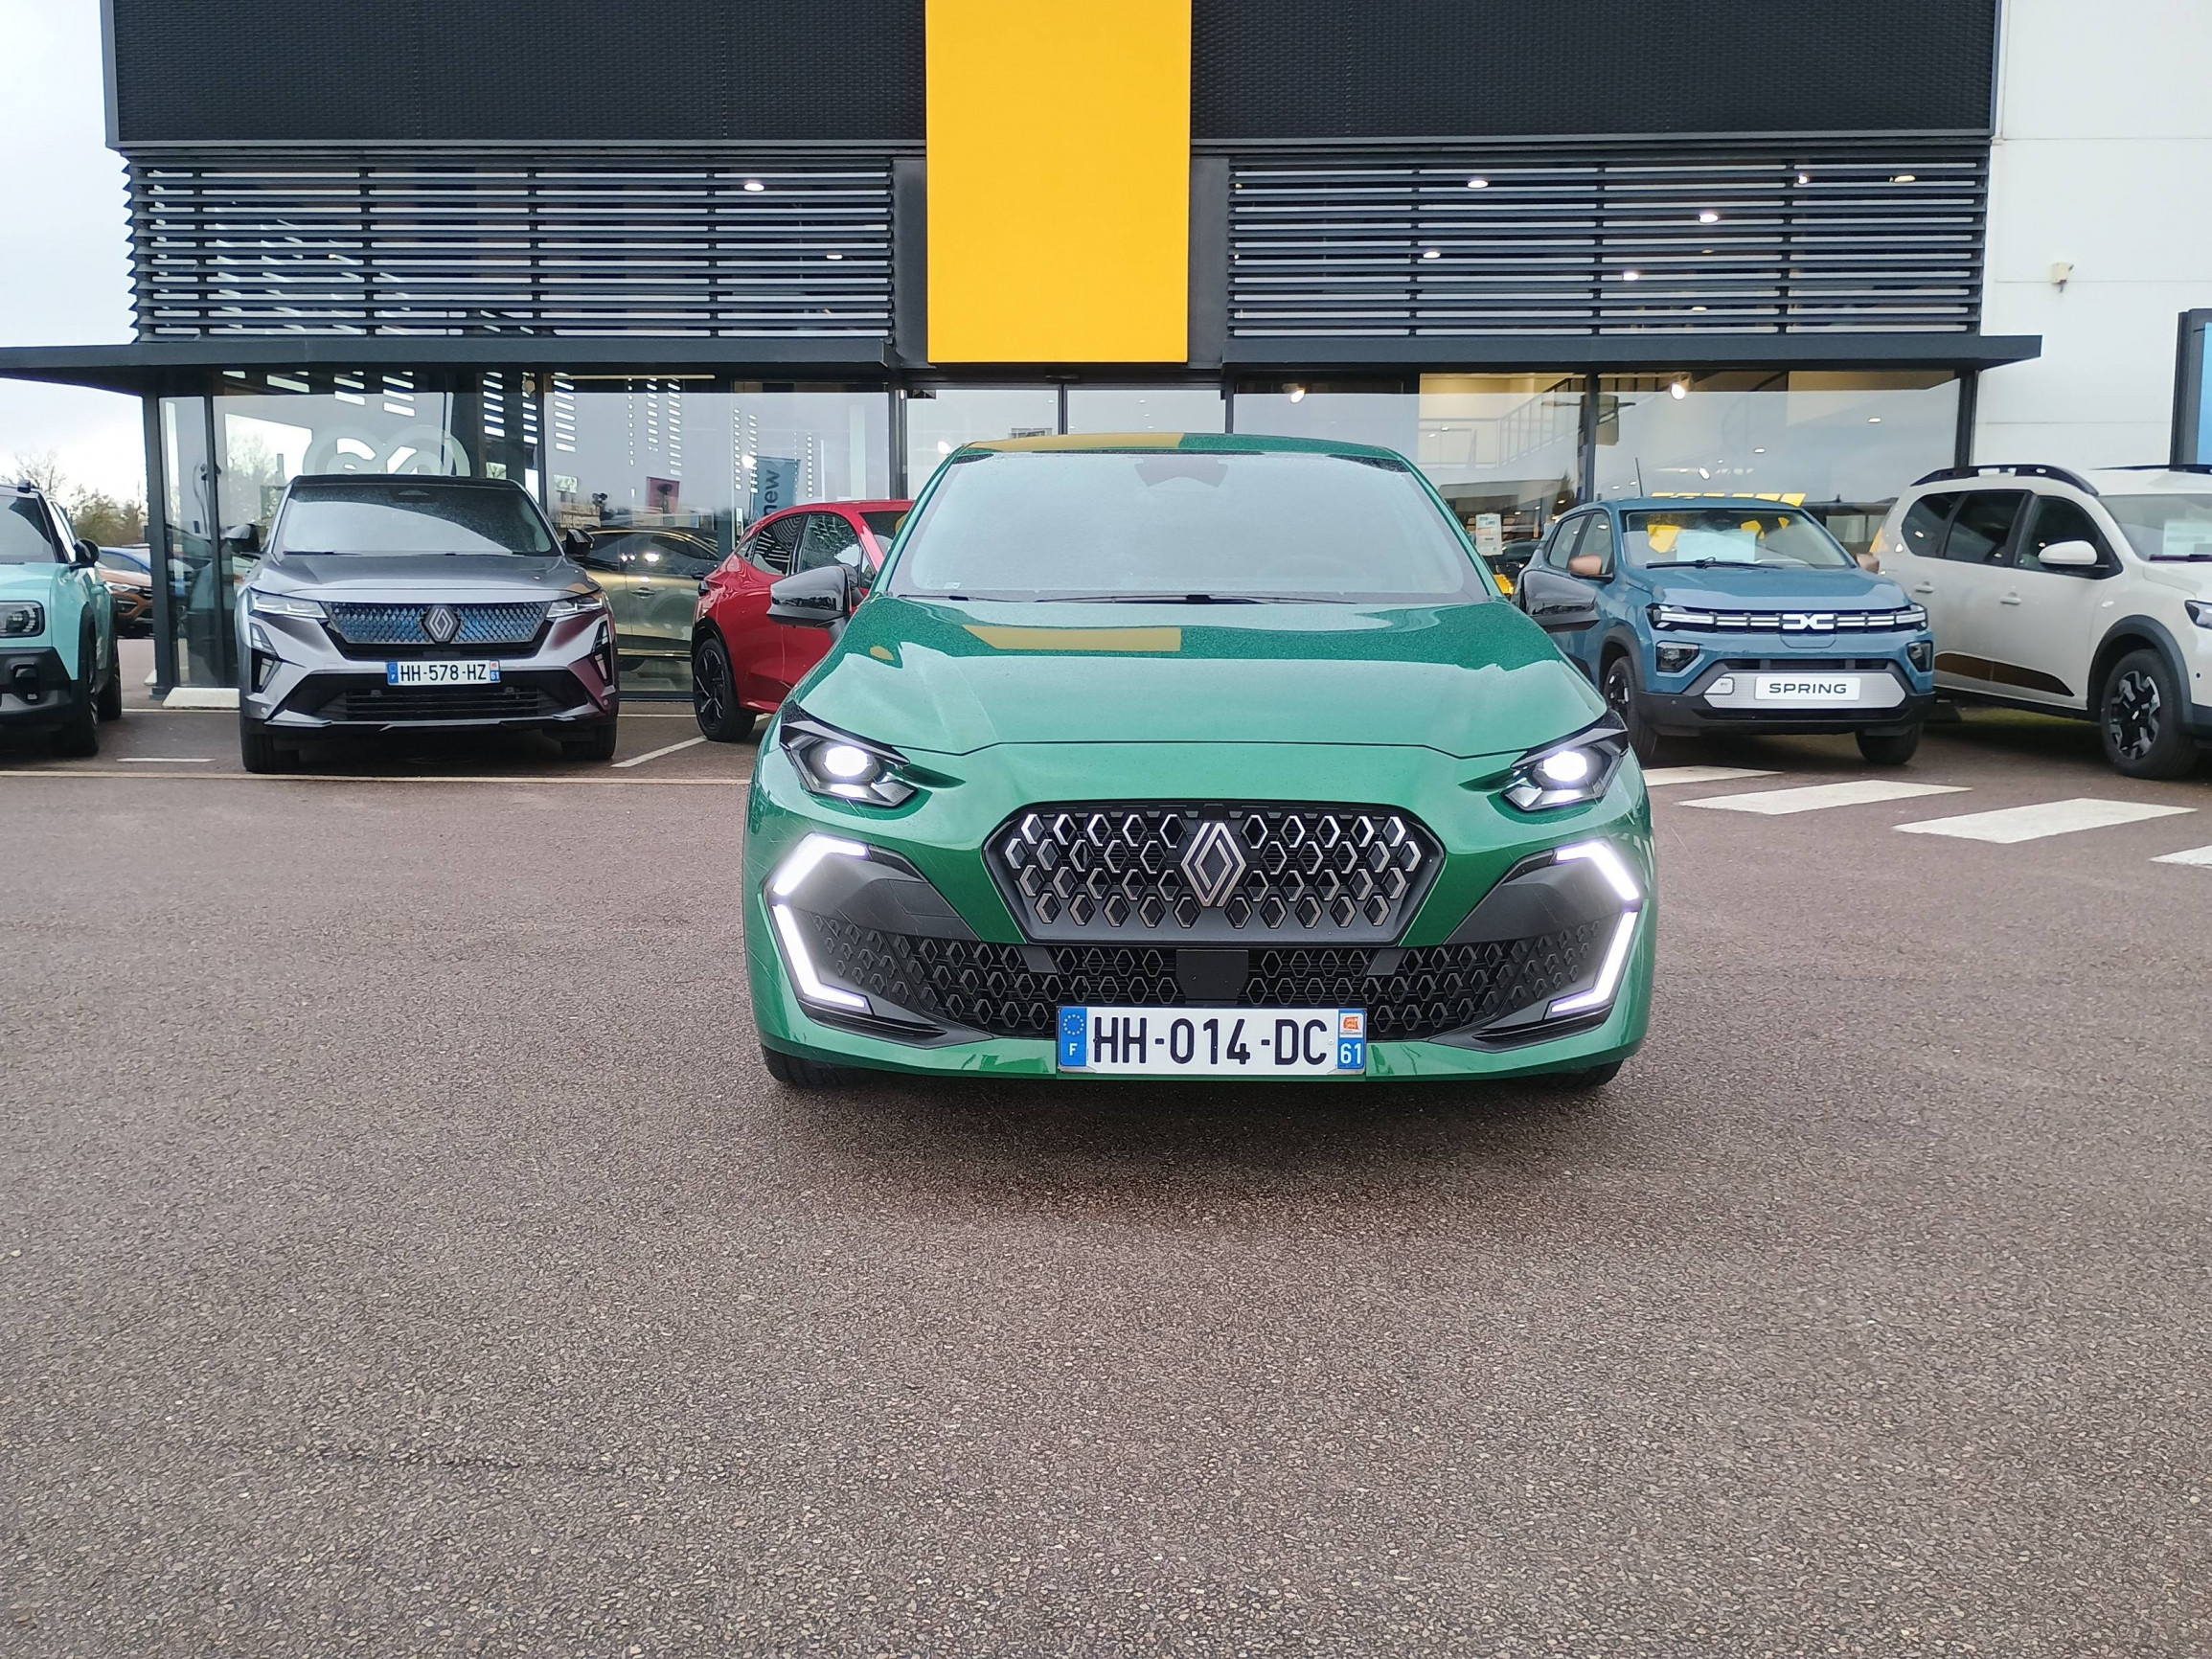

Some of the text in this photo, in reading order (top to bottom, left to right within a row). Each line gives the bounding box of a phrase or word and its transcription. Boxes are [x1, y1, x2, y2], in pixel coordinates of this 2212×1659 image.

[400, 664, 487, 682] HH-578-HZ
[490, 670, 500, 680] 61
[1769, 683, 1848, 694] SPRING
[1093, 1016, 1329, 1066] HH-014-DC
[1069, 1042, 1079, 1057] F
[1340, 1042, 1362, 1065] 61
